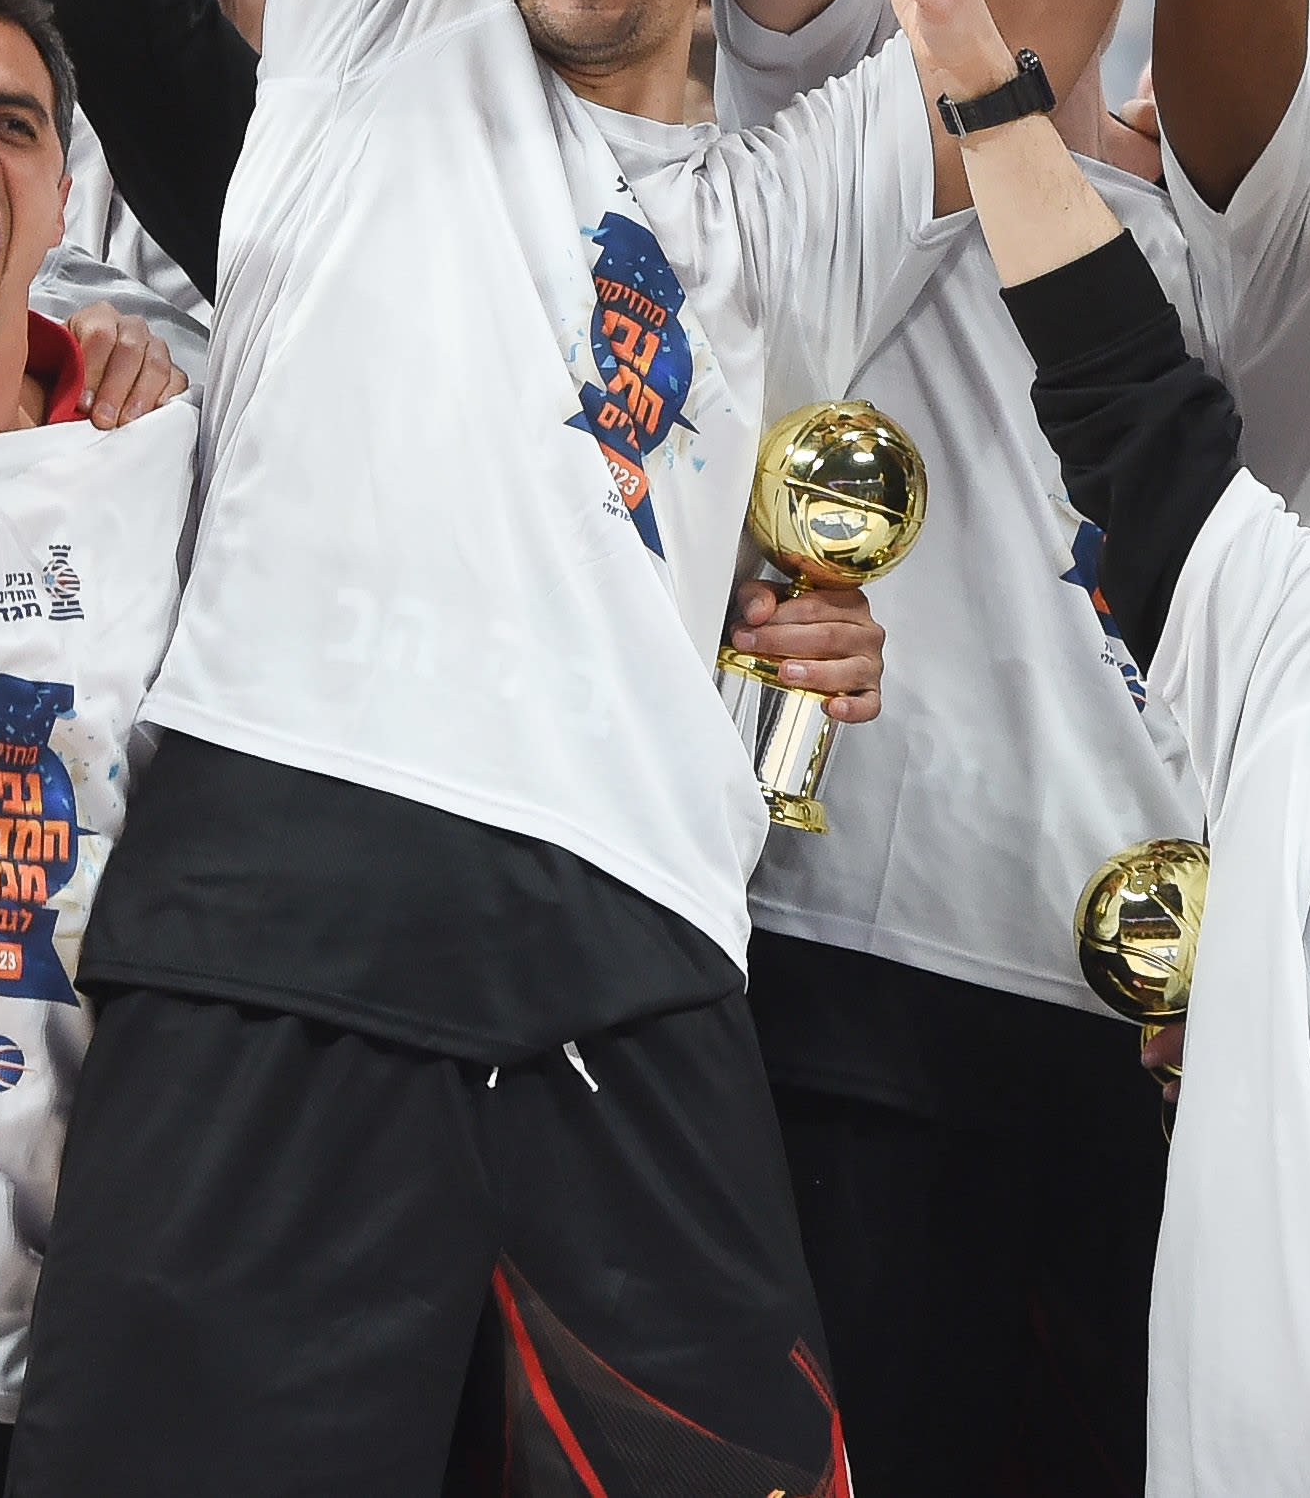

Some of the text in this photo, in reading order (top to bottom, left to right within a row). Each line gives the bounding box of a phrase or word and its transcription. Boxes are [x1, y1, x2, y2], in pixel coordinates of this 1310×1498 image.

[601, 309, 661, 378] גבי
[604, 455, 640, 496] 023
[5, 572, 34, 588] גביע
